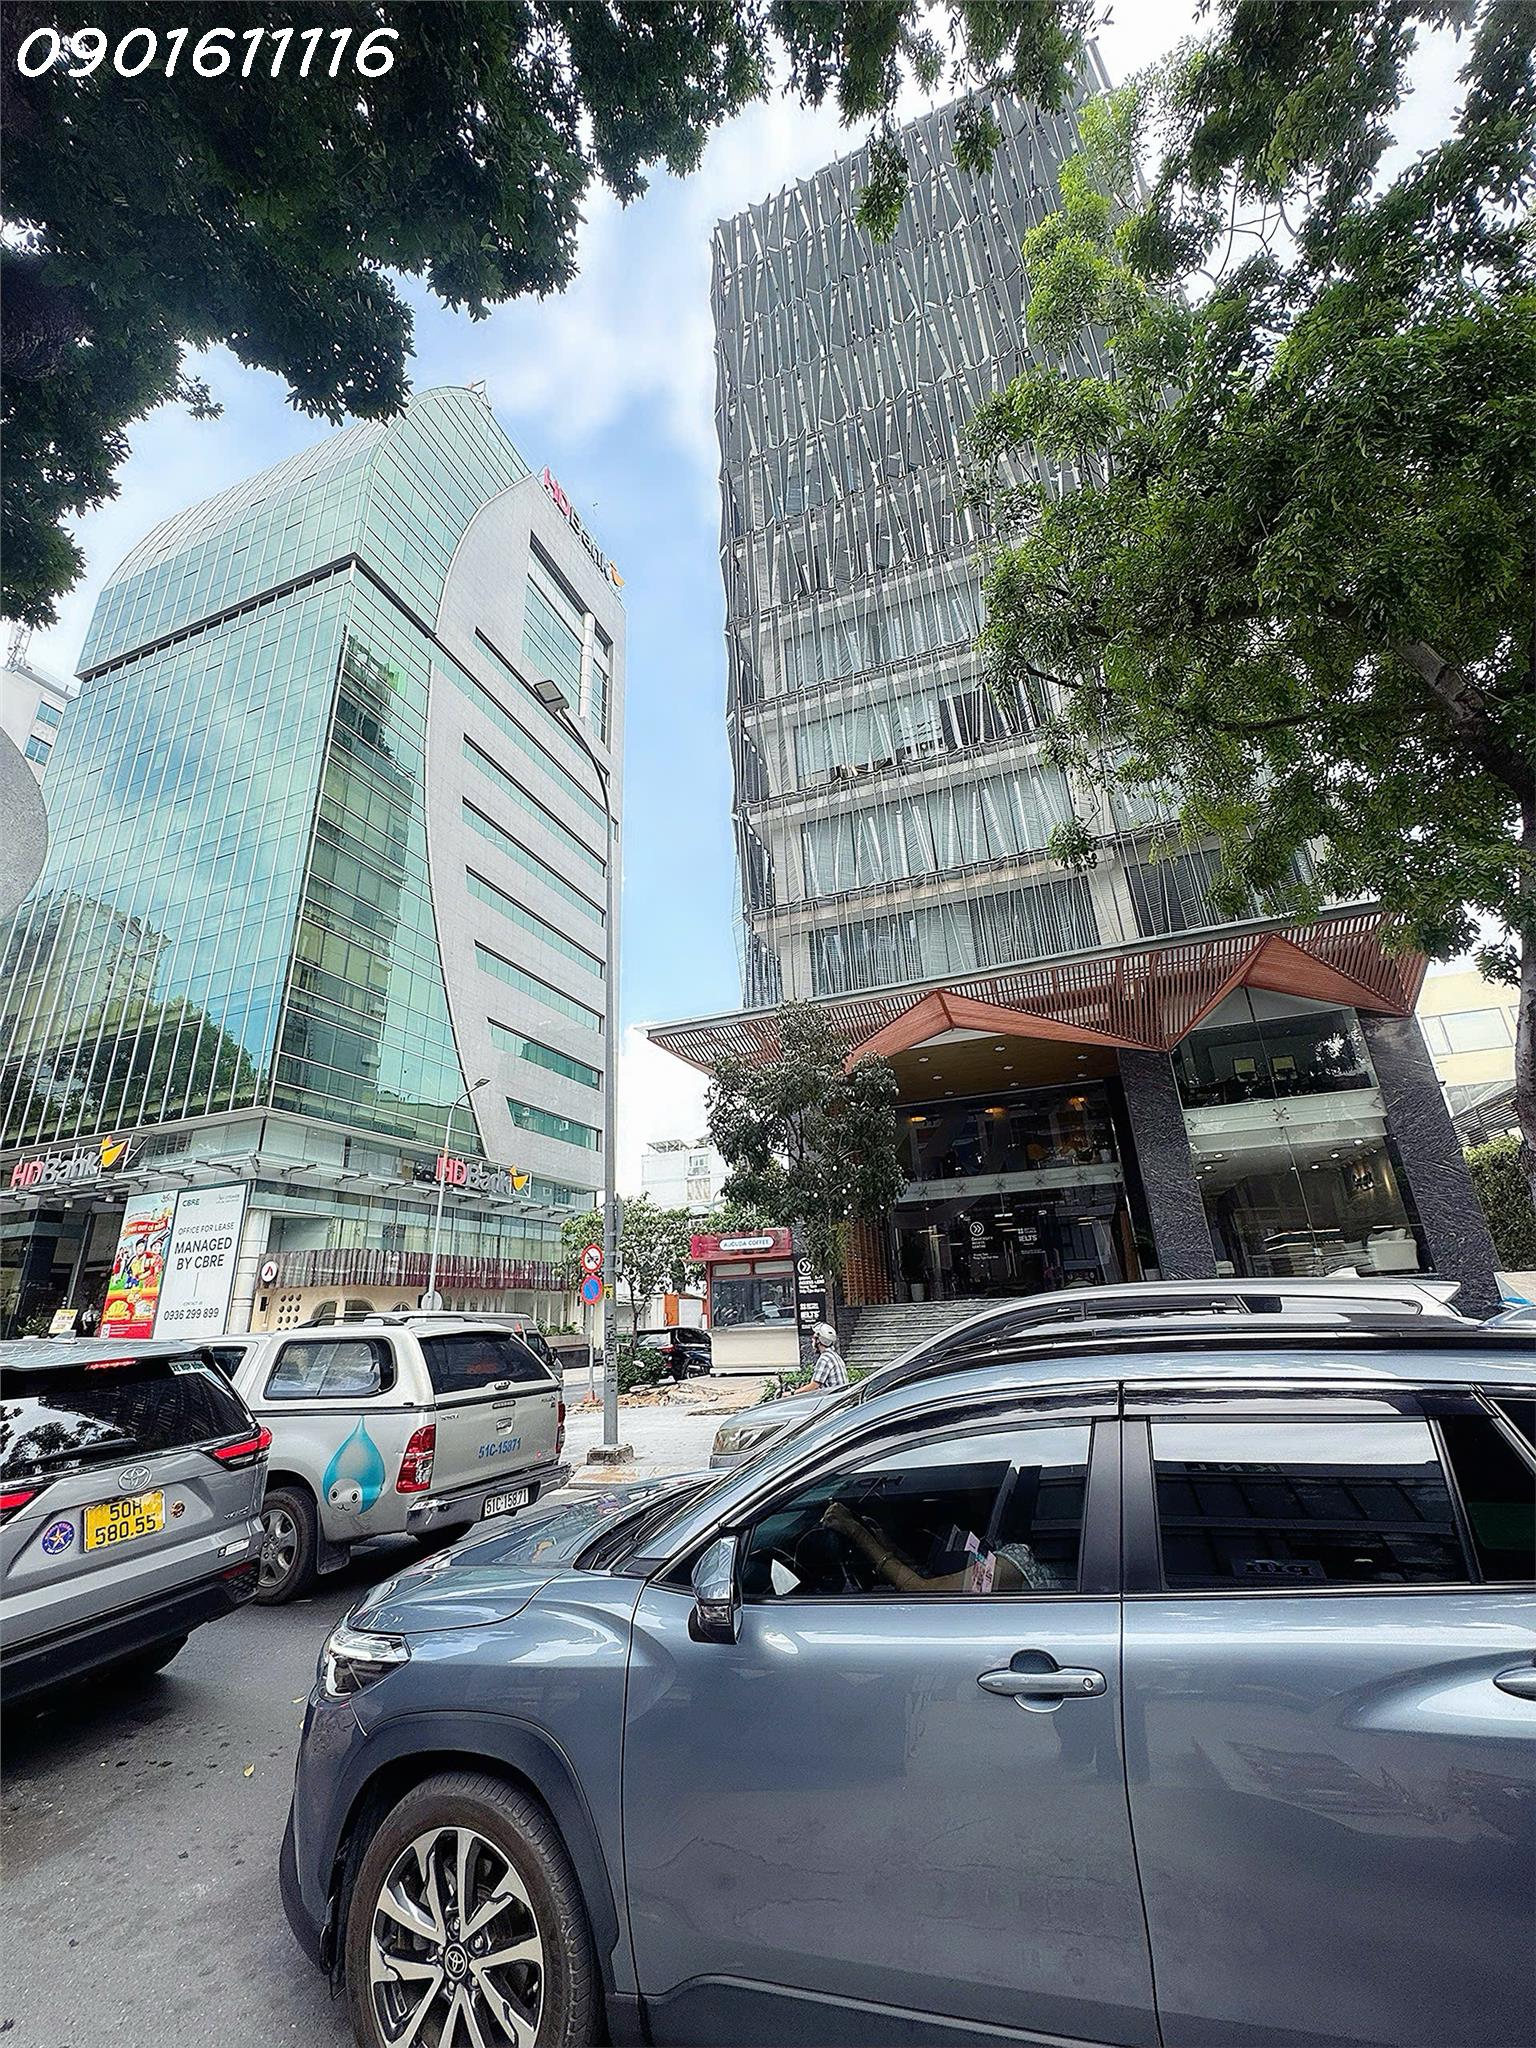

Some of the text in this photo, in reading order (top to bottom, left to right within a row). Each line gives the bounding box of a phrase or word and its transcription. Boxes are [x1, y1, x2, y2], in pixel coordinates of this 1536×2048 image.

[10, 1151, 98, 1188] HDBank
[435, 1156, 511, 1195] HDBank
[178, 1225, 200, 1236] OFFICE
[200, 1224, 214, 1234] FOR
[214, 1222, 235, 1232] LEASE
[175, 1237, 233, 1255] MANAGED
[176, 1254, 225, 1271] BY CBRE
[164, 1310, 185, 1321] 0936
[186, 1309, 202, 1320] 299
[203, 1307, 220, 1319] 899
[478, 1437, 522, 1459] 51C-15871
[485, 1488, 528, 1515] 51C-15871
[95, 1516, 156, 1545] 580.55
